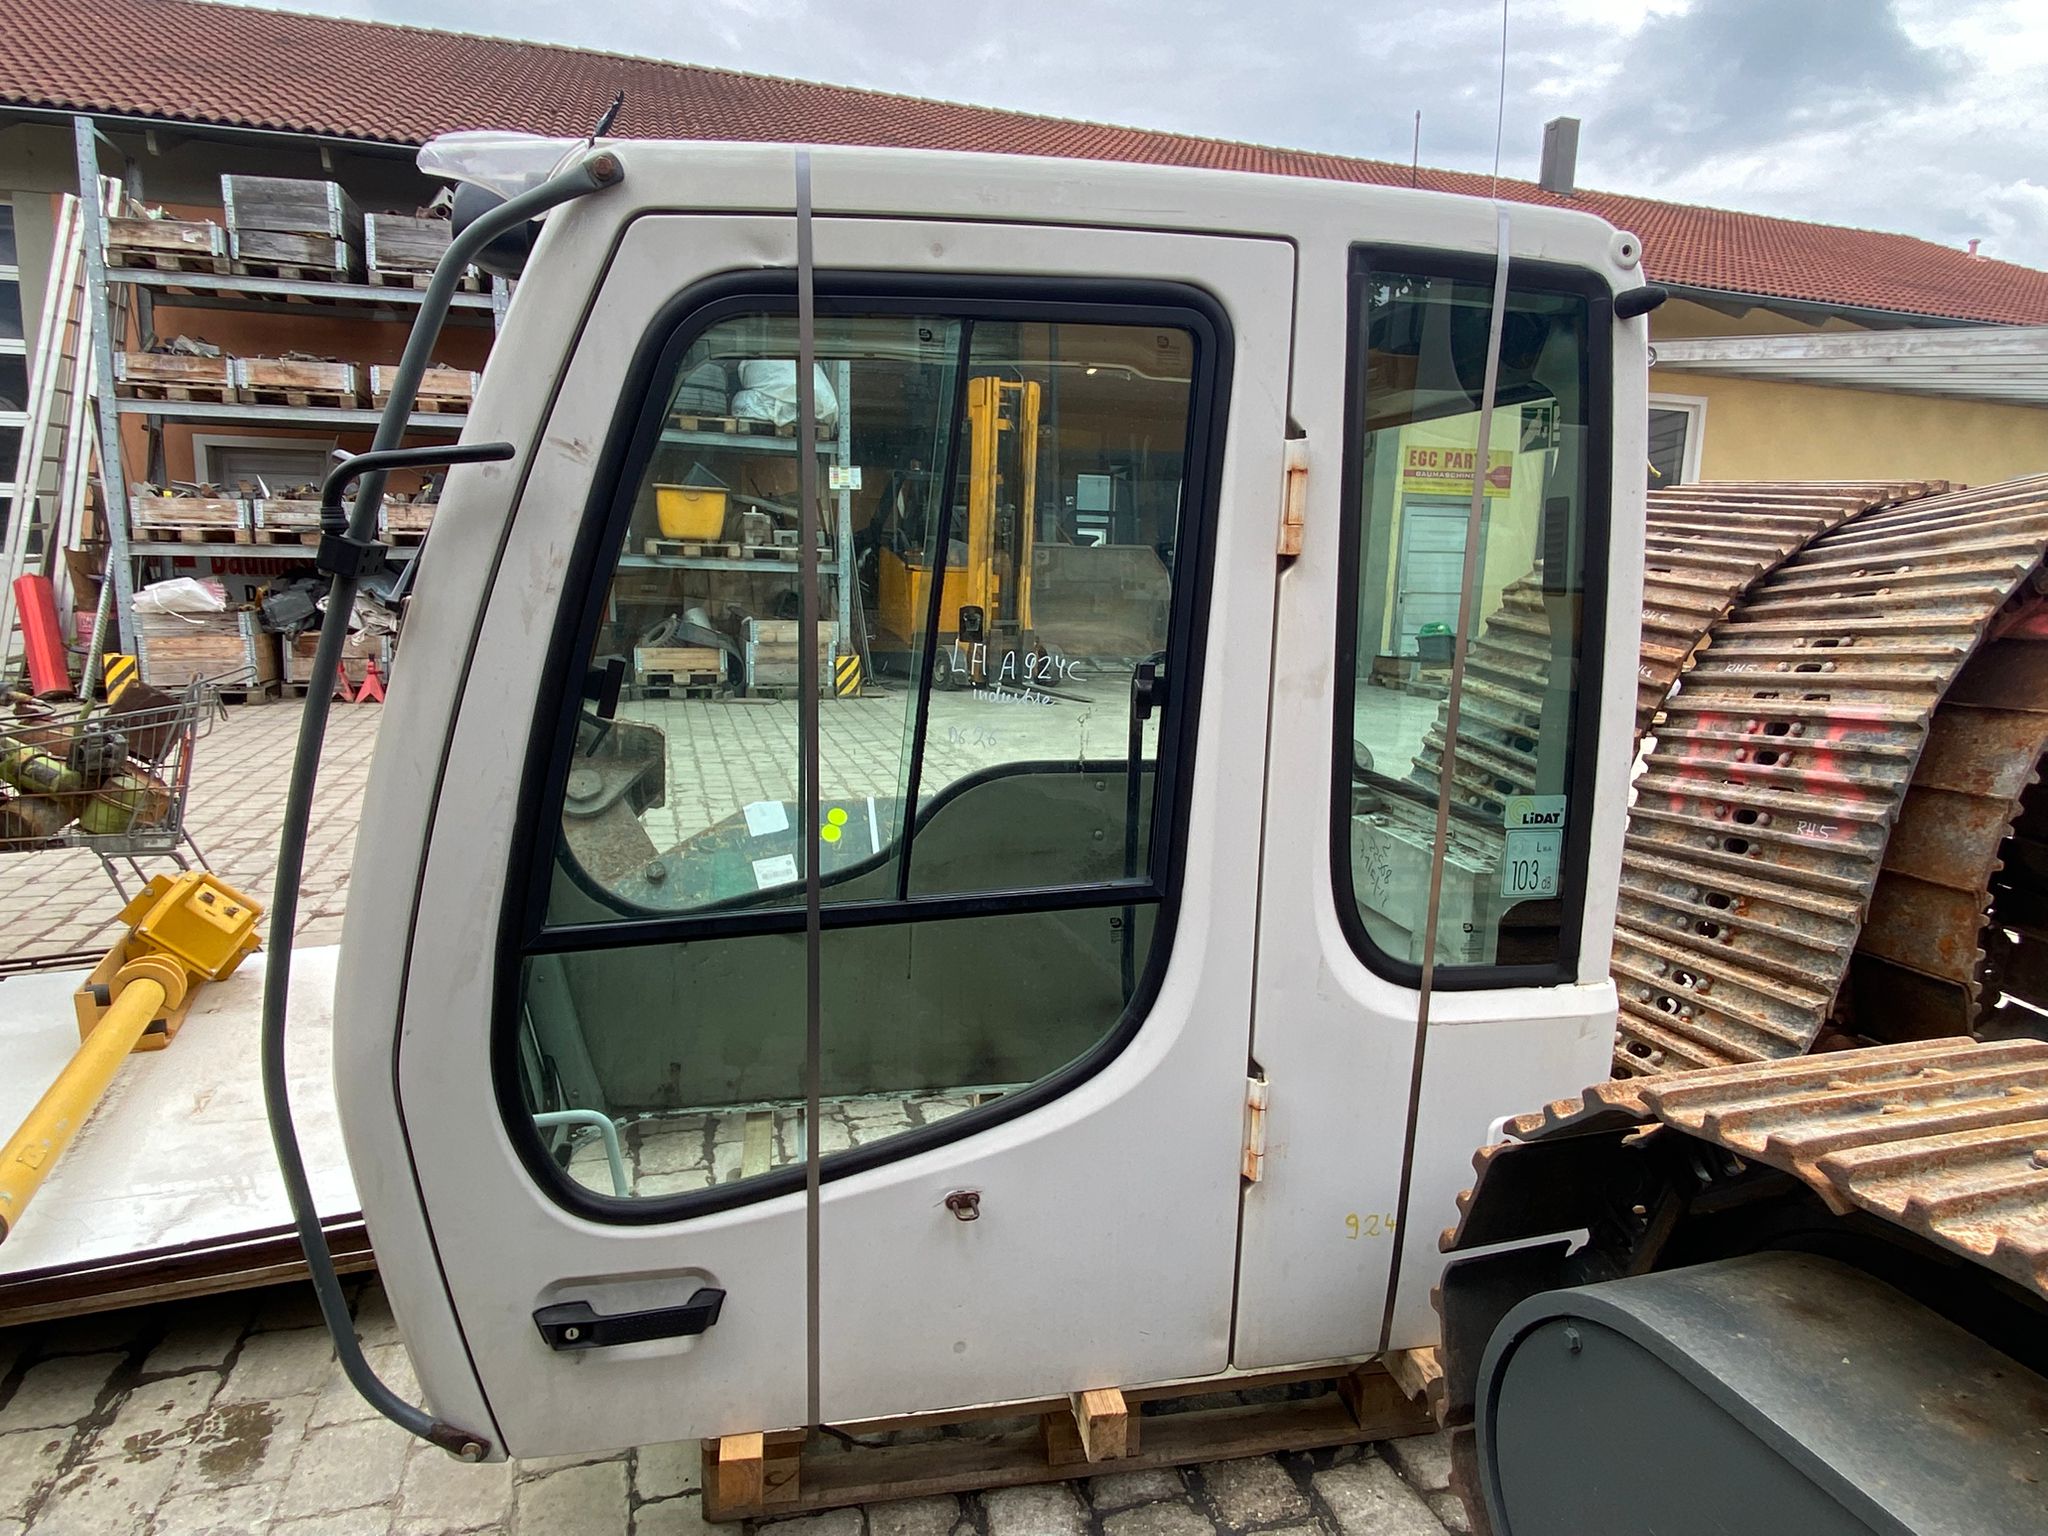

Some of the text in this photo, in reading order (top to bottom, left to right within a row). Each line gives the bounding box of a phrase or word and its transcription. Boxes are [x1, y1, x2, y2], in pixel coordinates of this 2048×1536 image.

[1410, 450, 1438, 468] EGC
[1512, 859, 1539, 891] 103
[1344, 1212, 1397, 1240] 924
